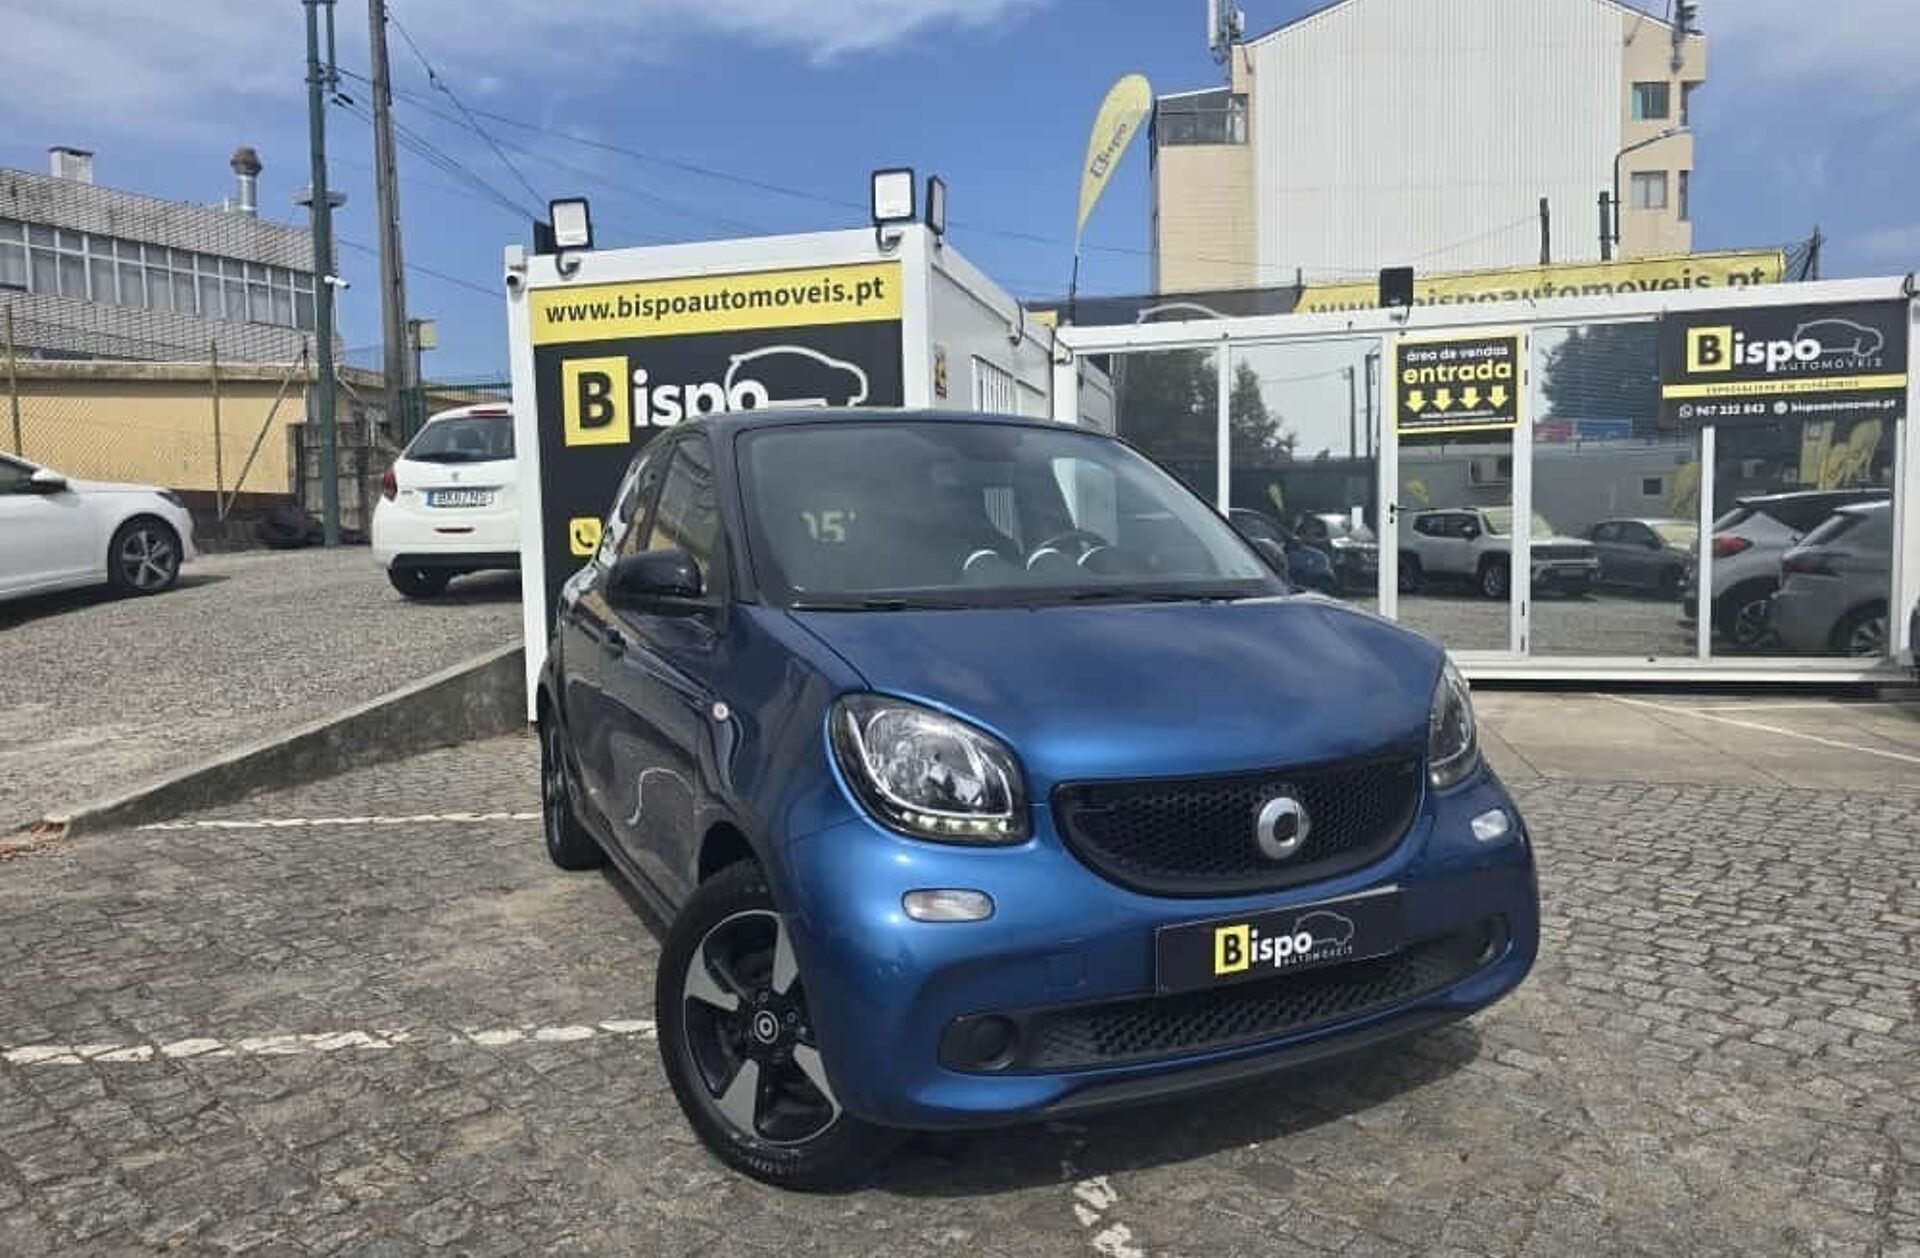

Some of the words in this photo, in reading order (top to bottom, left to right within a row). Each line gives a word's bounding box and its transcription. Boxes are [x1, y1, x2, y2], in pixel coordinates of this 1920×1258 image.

[545, 276, 885, 324] www.bispoautomoveis.pt
[1403, 359, 1512, 384] entrada
[1697, 331, 1821, 372] Bispo
[578, 368, 769, 430] Bispo
[1223, 928, 1313, 968] Bispo
